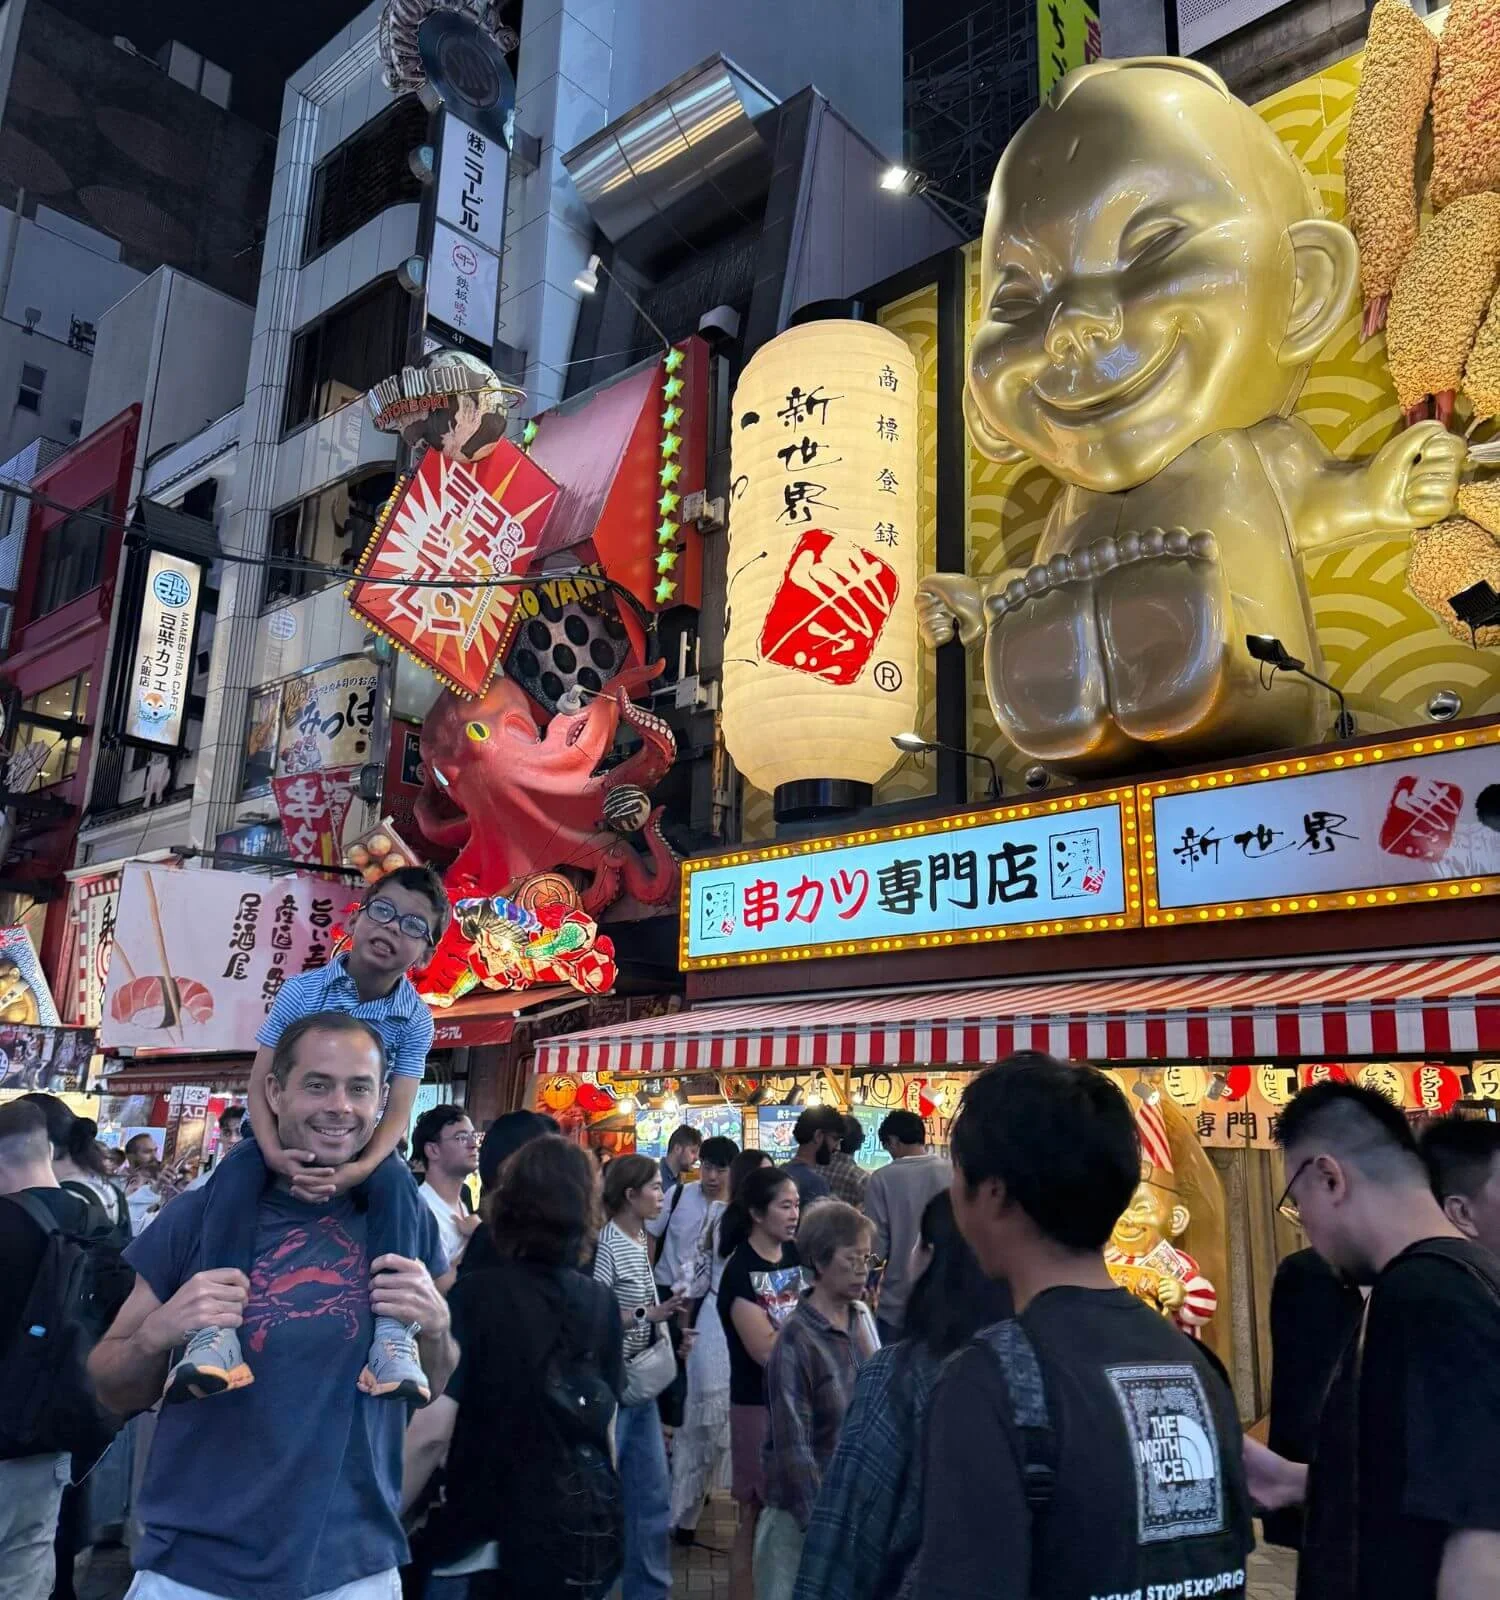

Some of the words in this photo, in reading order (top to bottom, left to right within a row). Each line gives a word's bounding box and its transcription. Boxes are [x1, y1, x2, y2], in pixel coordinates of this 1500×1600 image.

[402, 366, 468, 401] MUSEUM
[775, 386, 844, 526] 新世界
[875, 365, 899, 547] 商標登録
[154, 611, 177, 692] 豆柴カフェ
[174, 611, 190, 677] MAMESHIBA
[139, 655, 153, 688] 大阪店
[169, 680, 181, 712] CAFE
[1173, 811, 1359, 872] 新世界
[743, 842, 1038, 932] 串カツ専門店
[222, 893, 261, 980] 居酒屋
[1140, 1437, 1180, 1463] NORTH
[1151, 1416, 1178, 1437] THE
[1152, 1460, 1184, 1484] FACE
[1146, 1582, 1183, 1600] STOP
